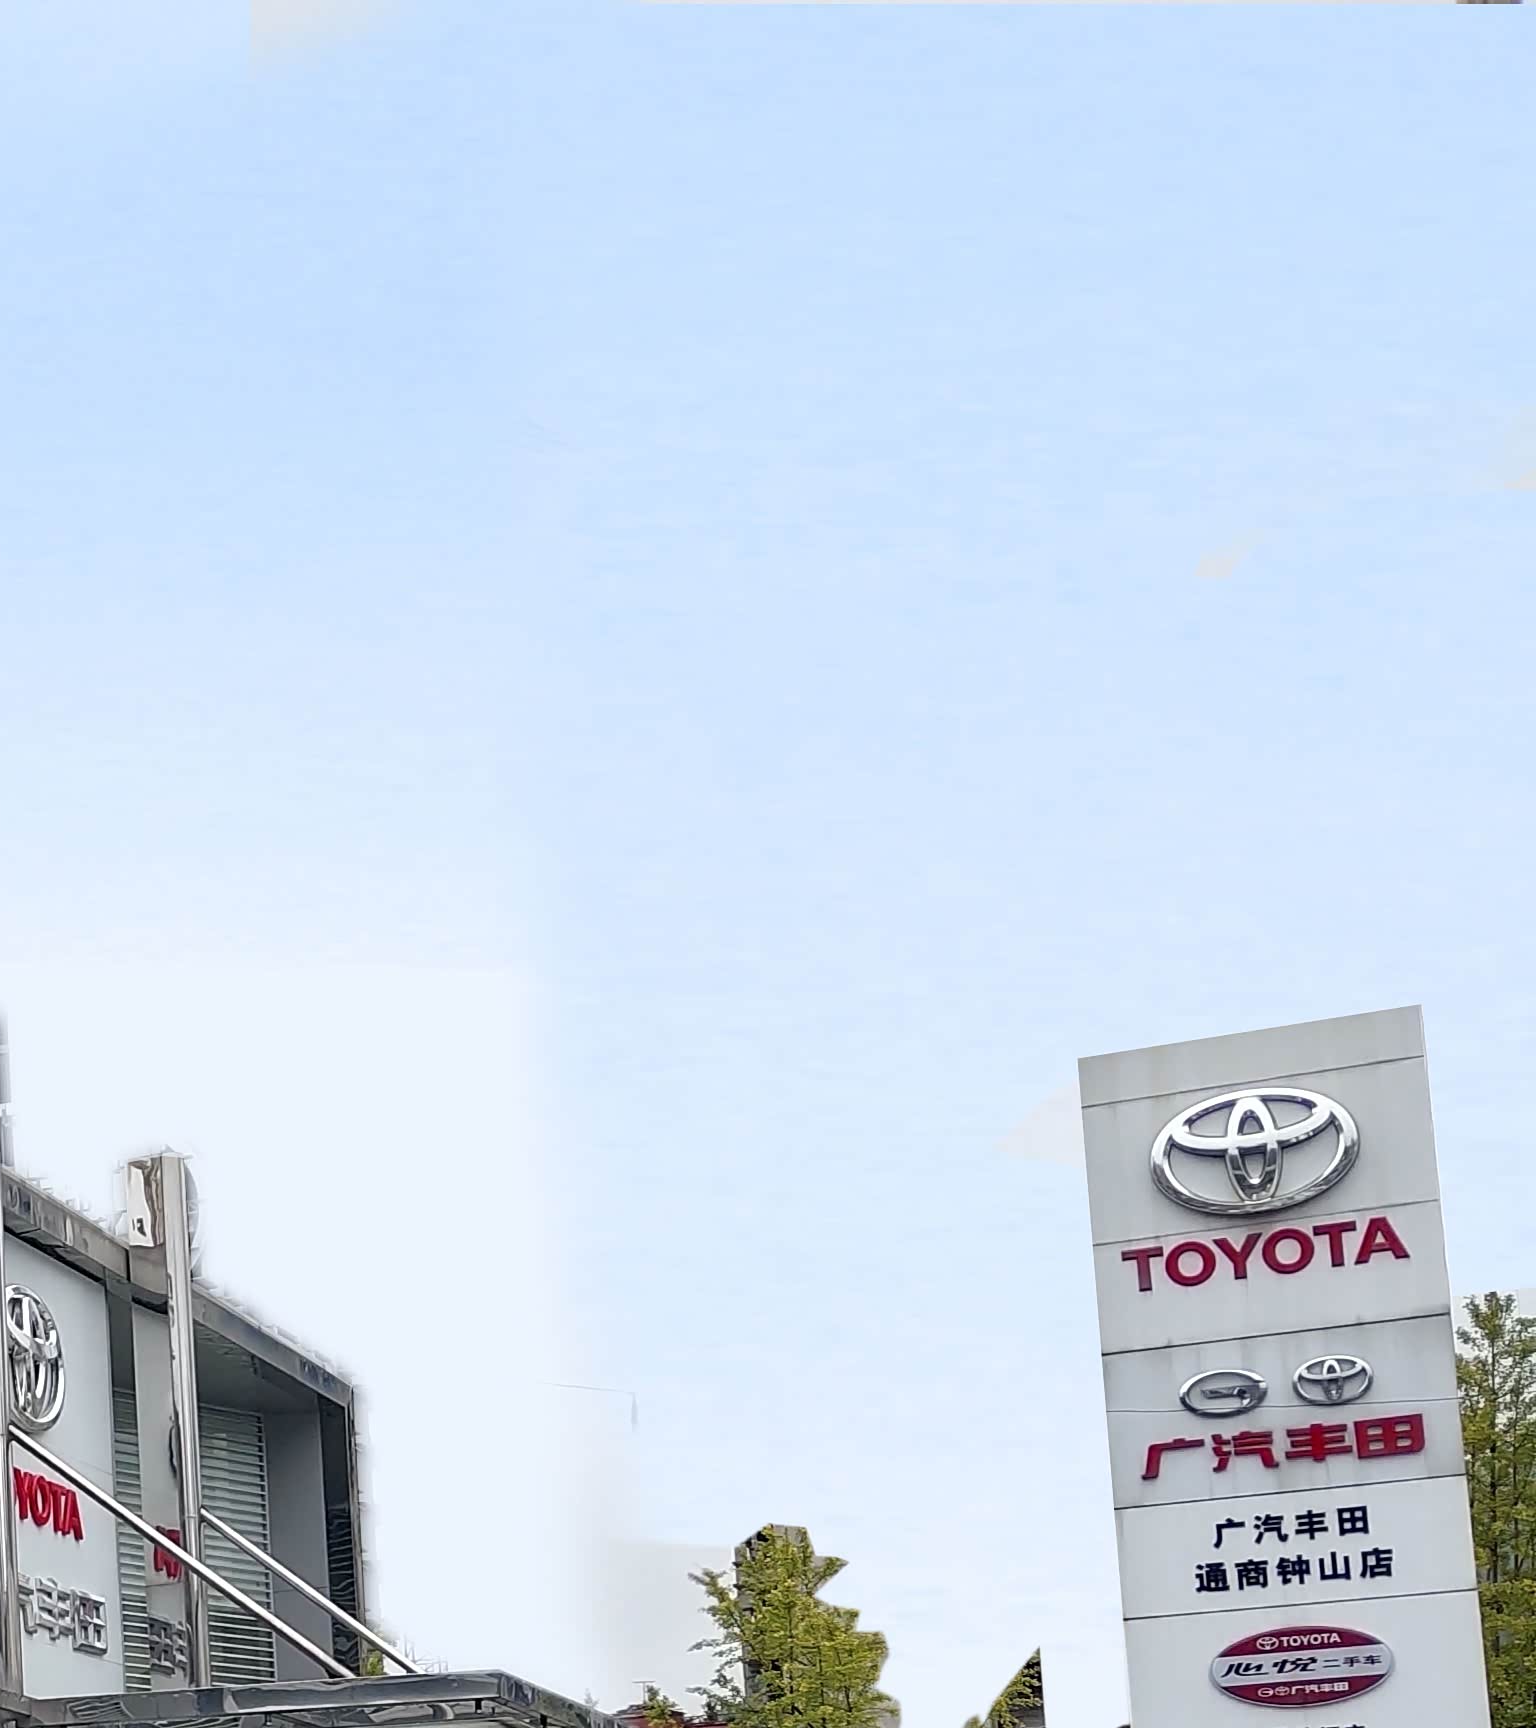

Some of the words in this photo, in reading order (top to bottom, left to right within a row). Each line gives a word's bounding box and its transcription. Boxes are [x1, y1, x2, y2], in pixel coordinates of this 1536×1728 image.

[1121, 1216, 1411, 1293] TOYOTA
[1141, 1413, 1426, 1481] 广汽丰田
[1213, 1505, 1370, 1549] 广汽丰田
[1195, 1547, 1394, 1595] 通商钟山店
[1279, 1632, 1342, 1648] TOYOTA
[1290, 1682, 1350, 1695] 广汽丰田
